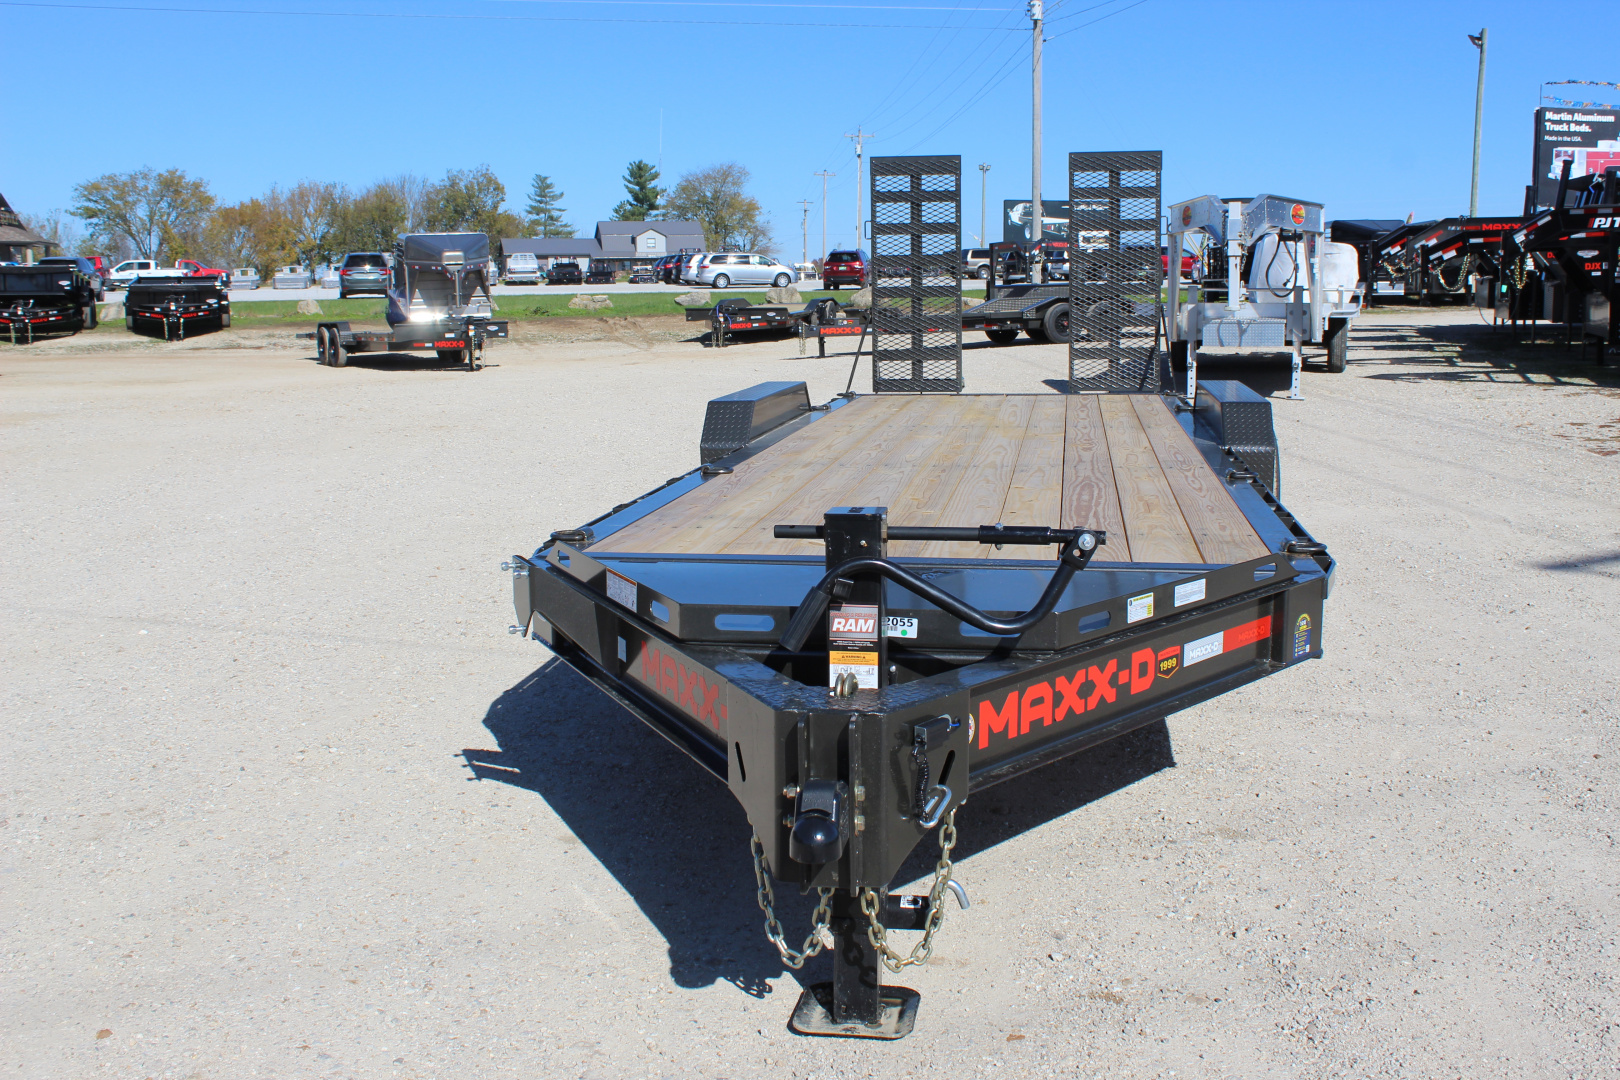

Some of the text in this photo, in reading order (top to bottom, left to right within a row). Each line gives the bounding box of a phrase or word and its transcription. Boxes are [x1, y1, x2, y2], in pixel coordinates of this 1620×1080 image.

[1545, 111, 1615, 122] Martin Aluminum
[1545, 122, 1592, 132] Truck Beds.
[1585, 262, 1601, 270] DJX
[820, 326, 862, 335] MAXX-D
[434, 340, 465, 348] MAXX-D
[832, 618, 875, 633] RAM
[1189, 641, 1219, 660] MAXX-D
[1160, 657, 1177, 672] 1999
[978, 646, 1156, 750] MAXX-D
